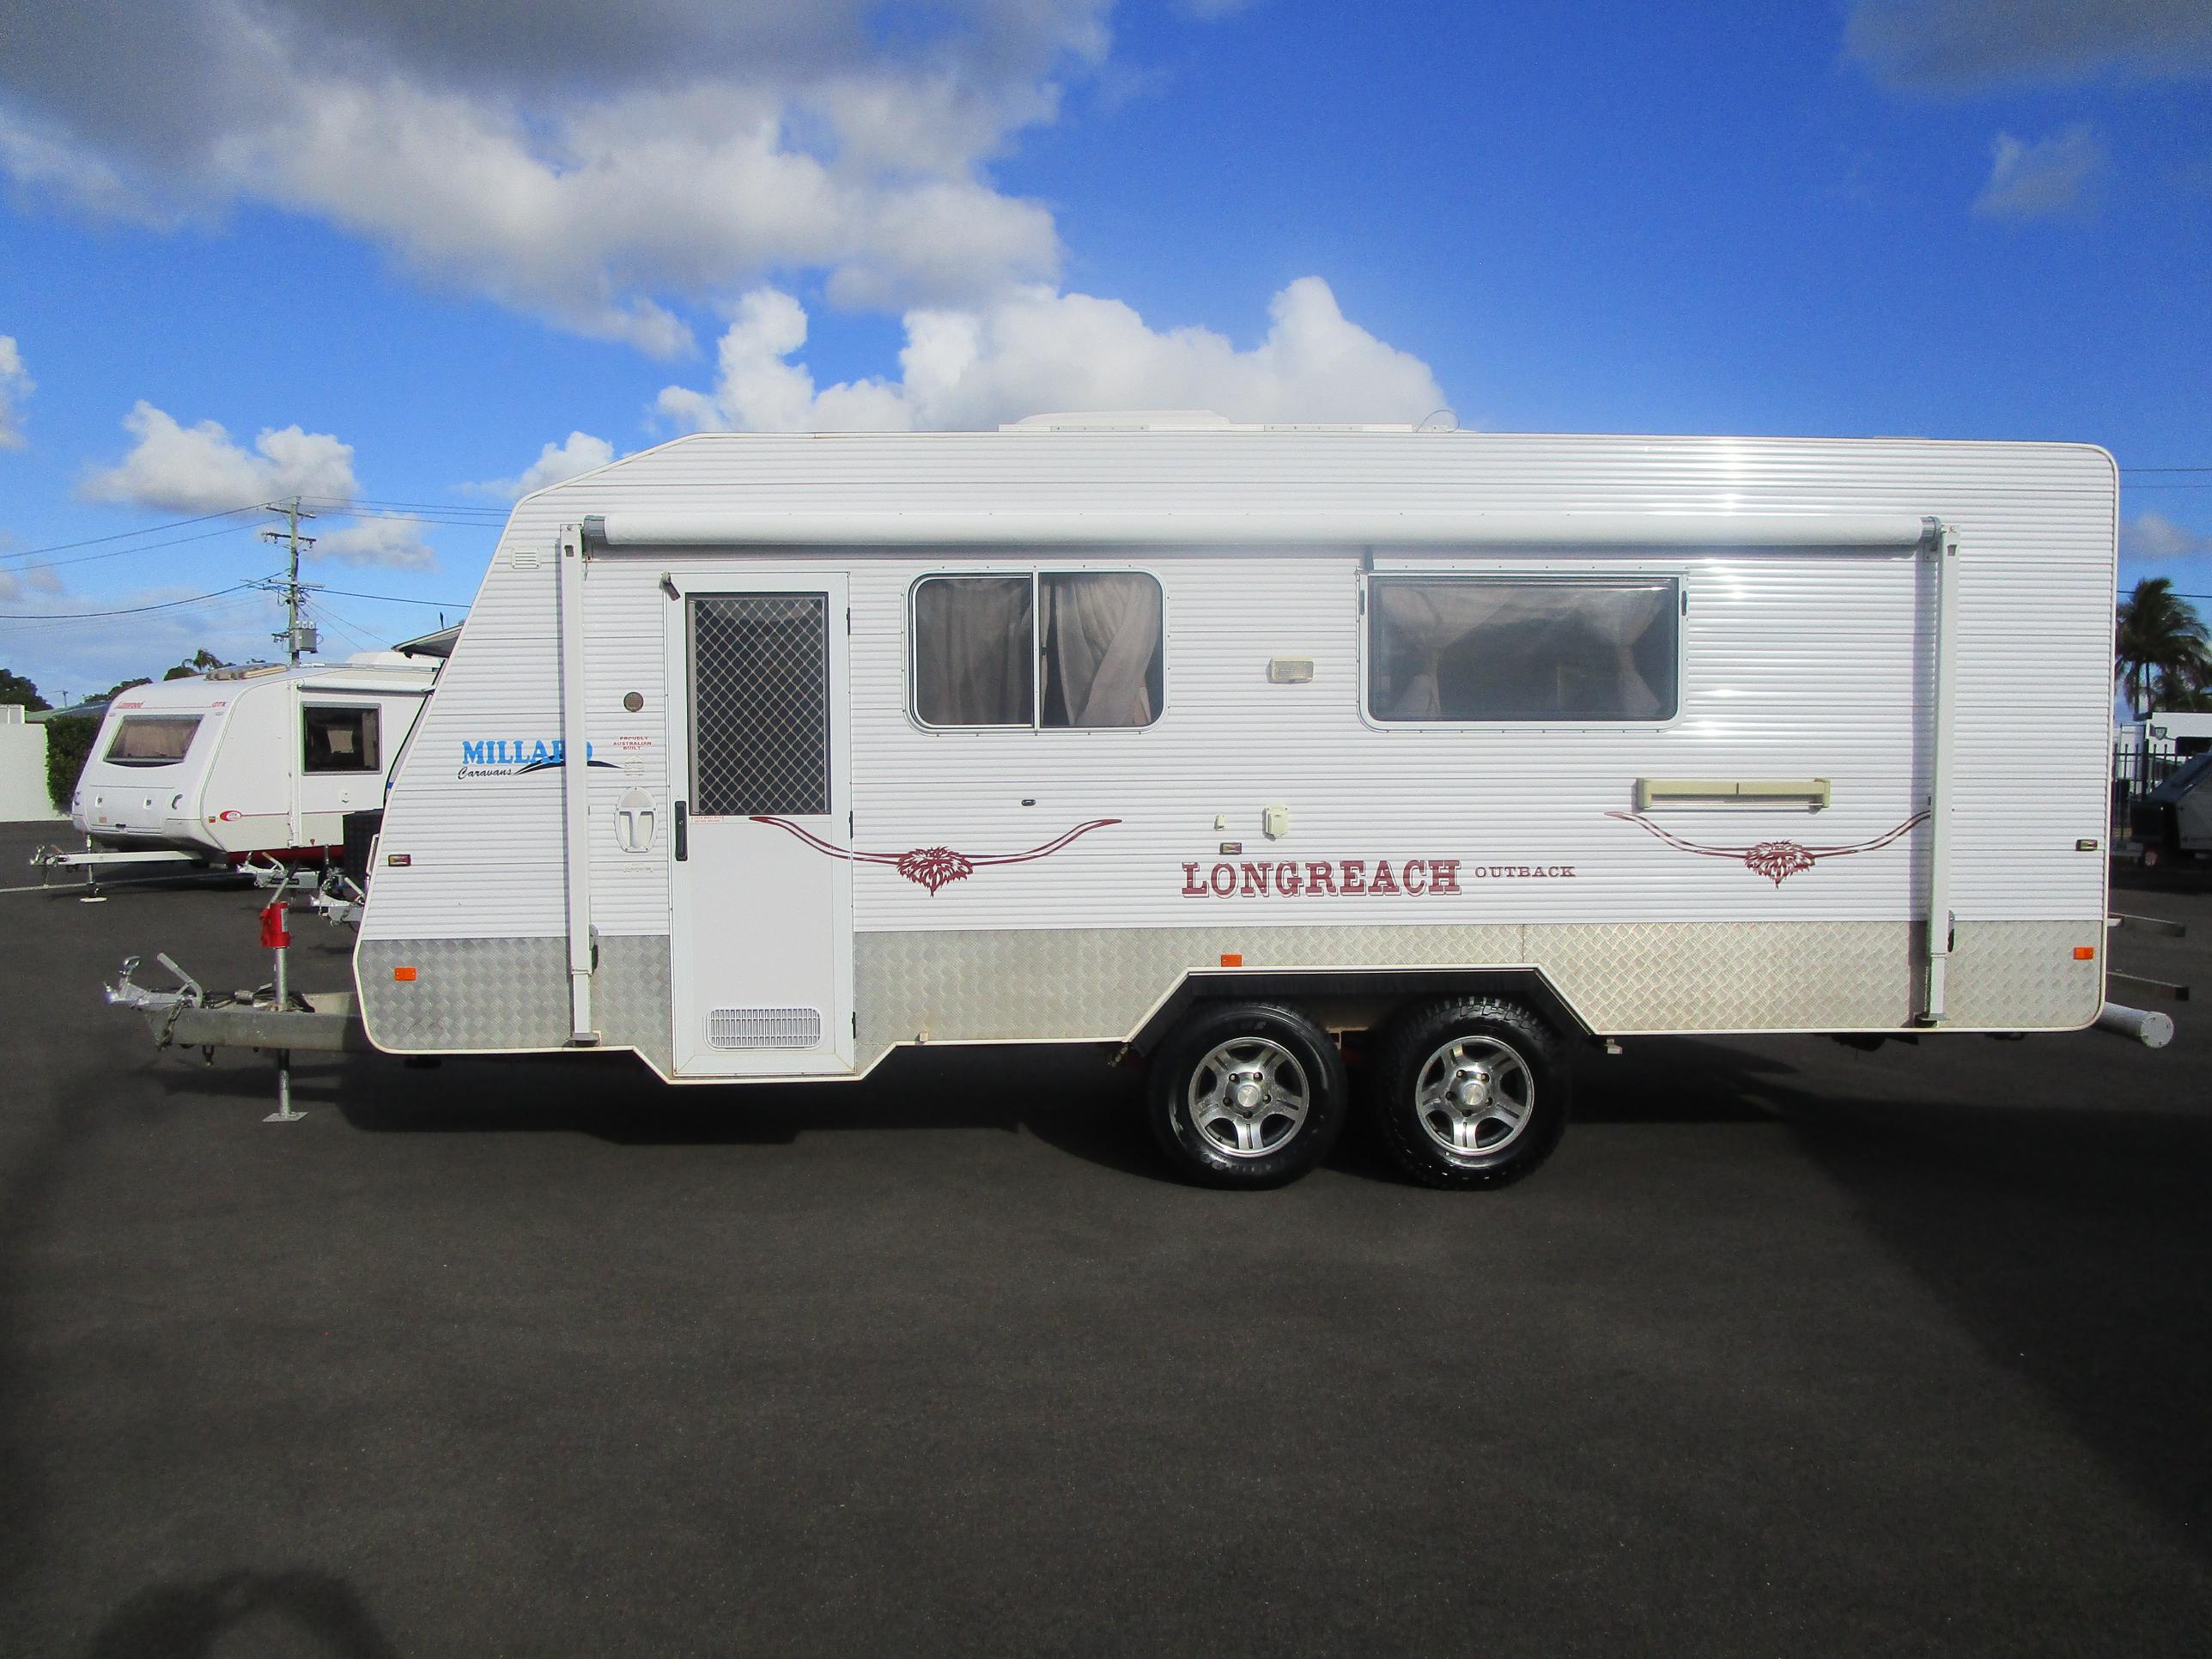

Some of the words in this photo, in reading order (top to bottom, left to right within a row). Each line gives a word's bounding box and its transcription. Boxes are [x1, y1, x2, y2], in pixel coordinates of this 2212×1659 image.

[461, 740, 593, 764] MILLAR
[458, 767, 513, 780] Caravans
[1182, 860, 1462, 898] LONGREACH
[1474, 866, 1577, 878] OUTBACK
